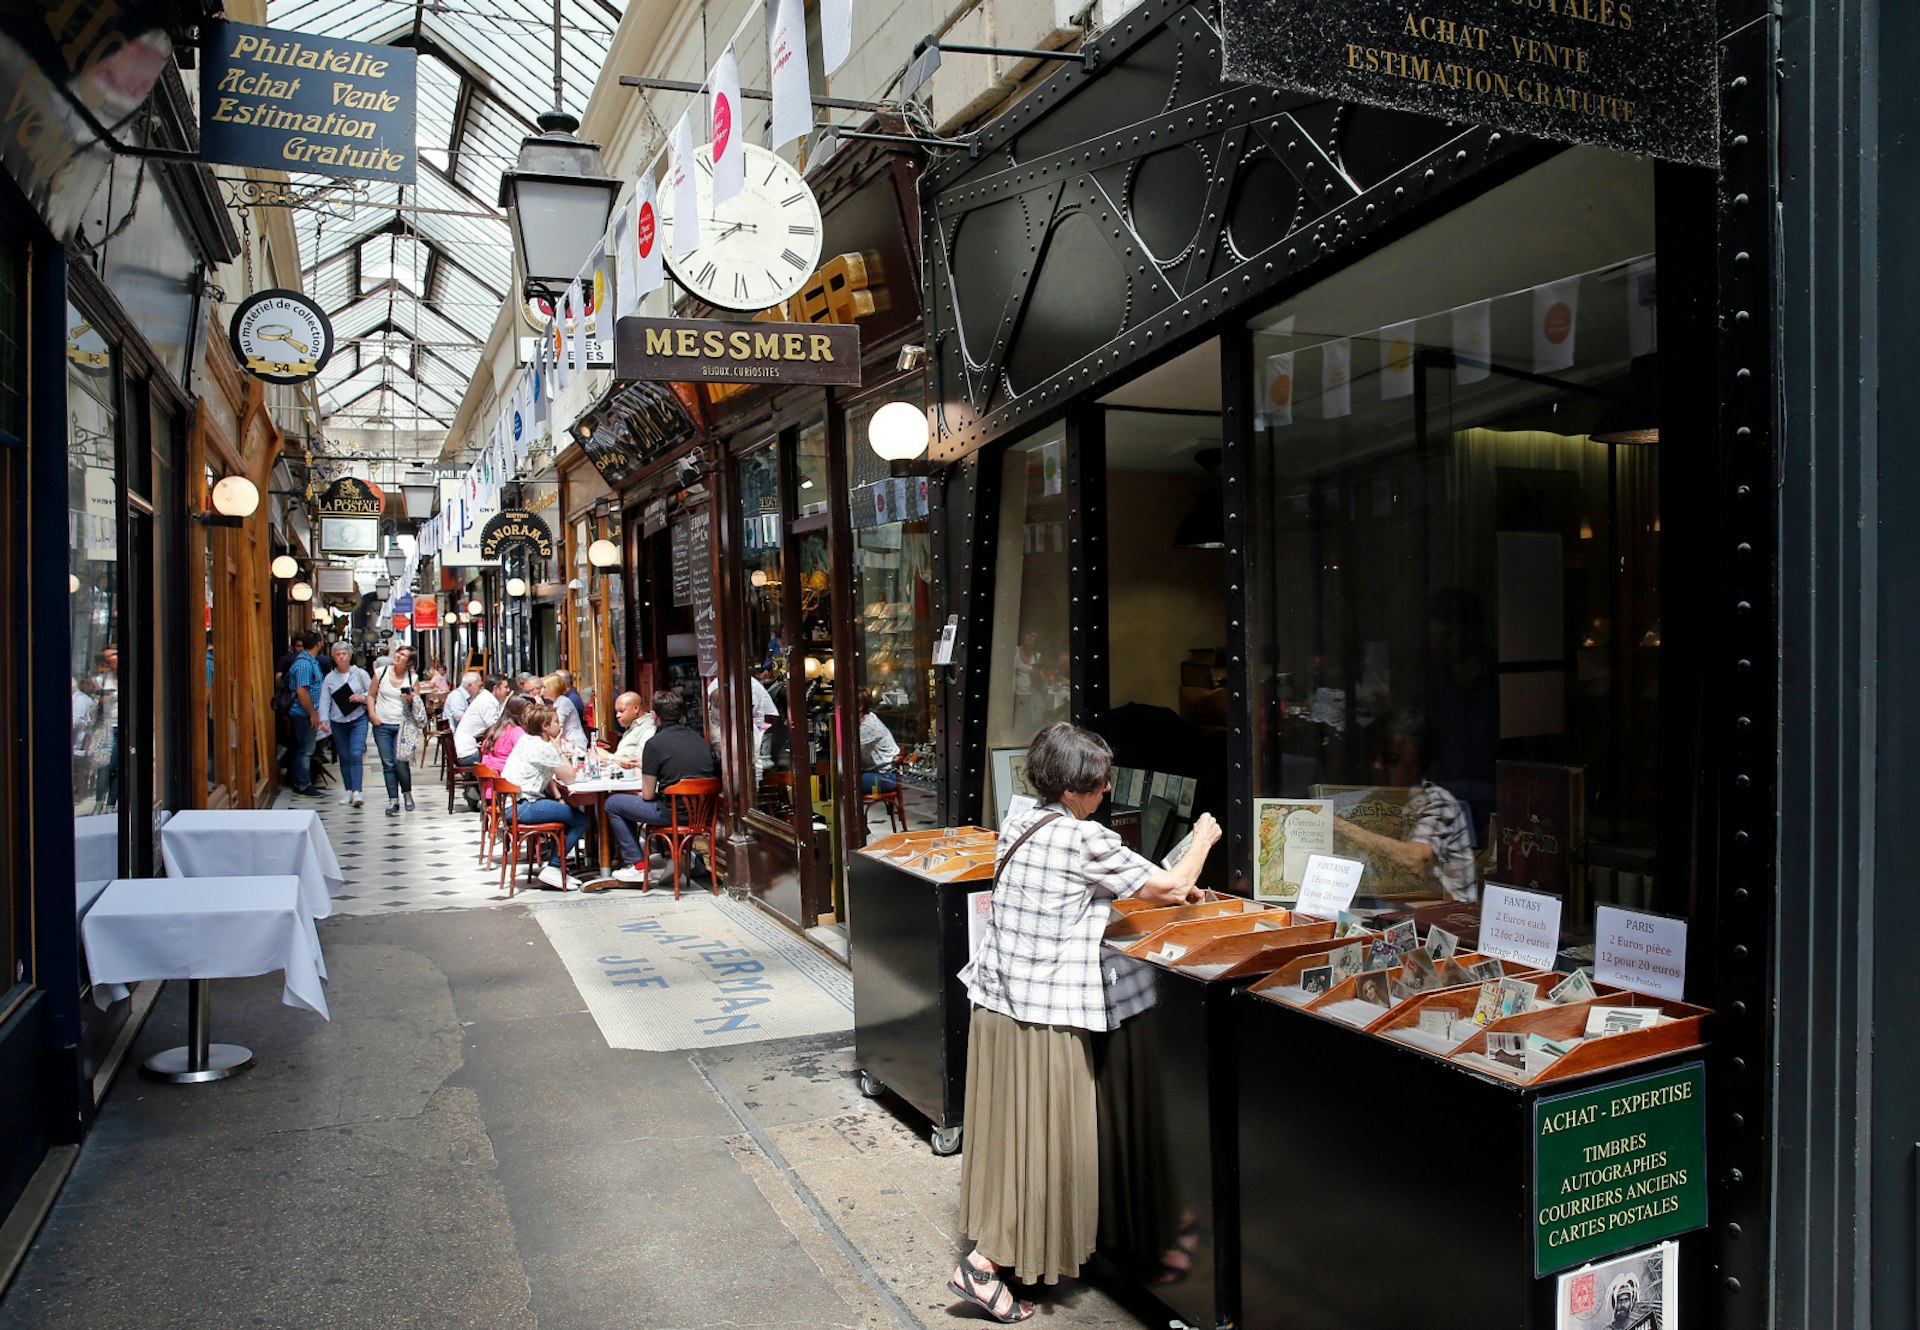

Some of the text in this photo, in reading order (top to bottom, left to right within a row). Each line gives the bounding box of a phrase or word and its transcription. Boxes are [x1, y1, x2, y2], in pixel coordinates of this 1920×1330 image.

[229, 34, 390, 79] Philatélie
[1402, 12, 1489, 51] ACHAT
[1511, 35, 1590, 74] VENTE
[217, 67, 401, 113] Achat Vente
[1346, 43, 1638, 124] ESTIMATION GRATUITE
[211, 97, 378, 140] Estimation
[282, 136, 406, 172] Gratuite
[242, 299, 322, 358] au matériel de collections
[645, 328, 835, 363] MESSMER
[273, 363, 290, 373] 54
[318, 498, 380, 512] LA POSTALE
[484, 524, 551, 556] PANORAMAS
[1496, 911, 1547, 931] 2 Euros each
[1504, 895, 1542, 912] FANTASY
[1490, 927, 1550, 949] 12 for 20 euros
[1626, 919, 1655, 934] PARIS
[1482, 942, 1552, 968] Vintage Postcards
[1609, 934, 1672, 957] 2 Euros pièce
[617, 920, 775, 1035] WATERMAN
[1601, 951, 1681, 978] 12 pour 20 euros
[1614, 972, 1635, 983] Cartes
[1541, 1104, 1599, 1136] ACHAT
[1610, 1081, 1693, 1119] EXPERTISE
[1583, 1132, 1647, 1164] TIMBRES
[1560, 1151, 1668, 1195] AUTOGRAPHES
[1538, 1169, 1688, 1227] COURRIERS ANCIENS
[1548, 1196, 1680, 1248] CARTES POSTALES
